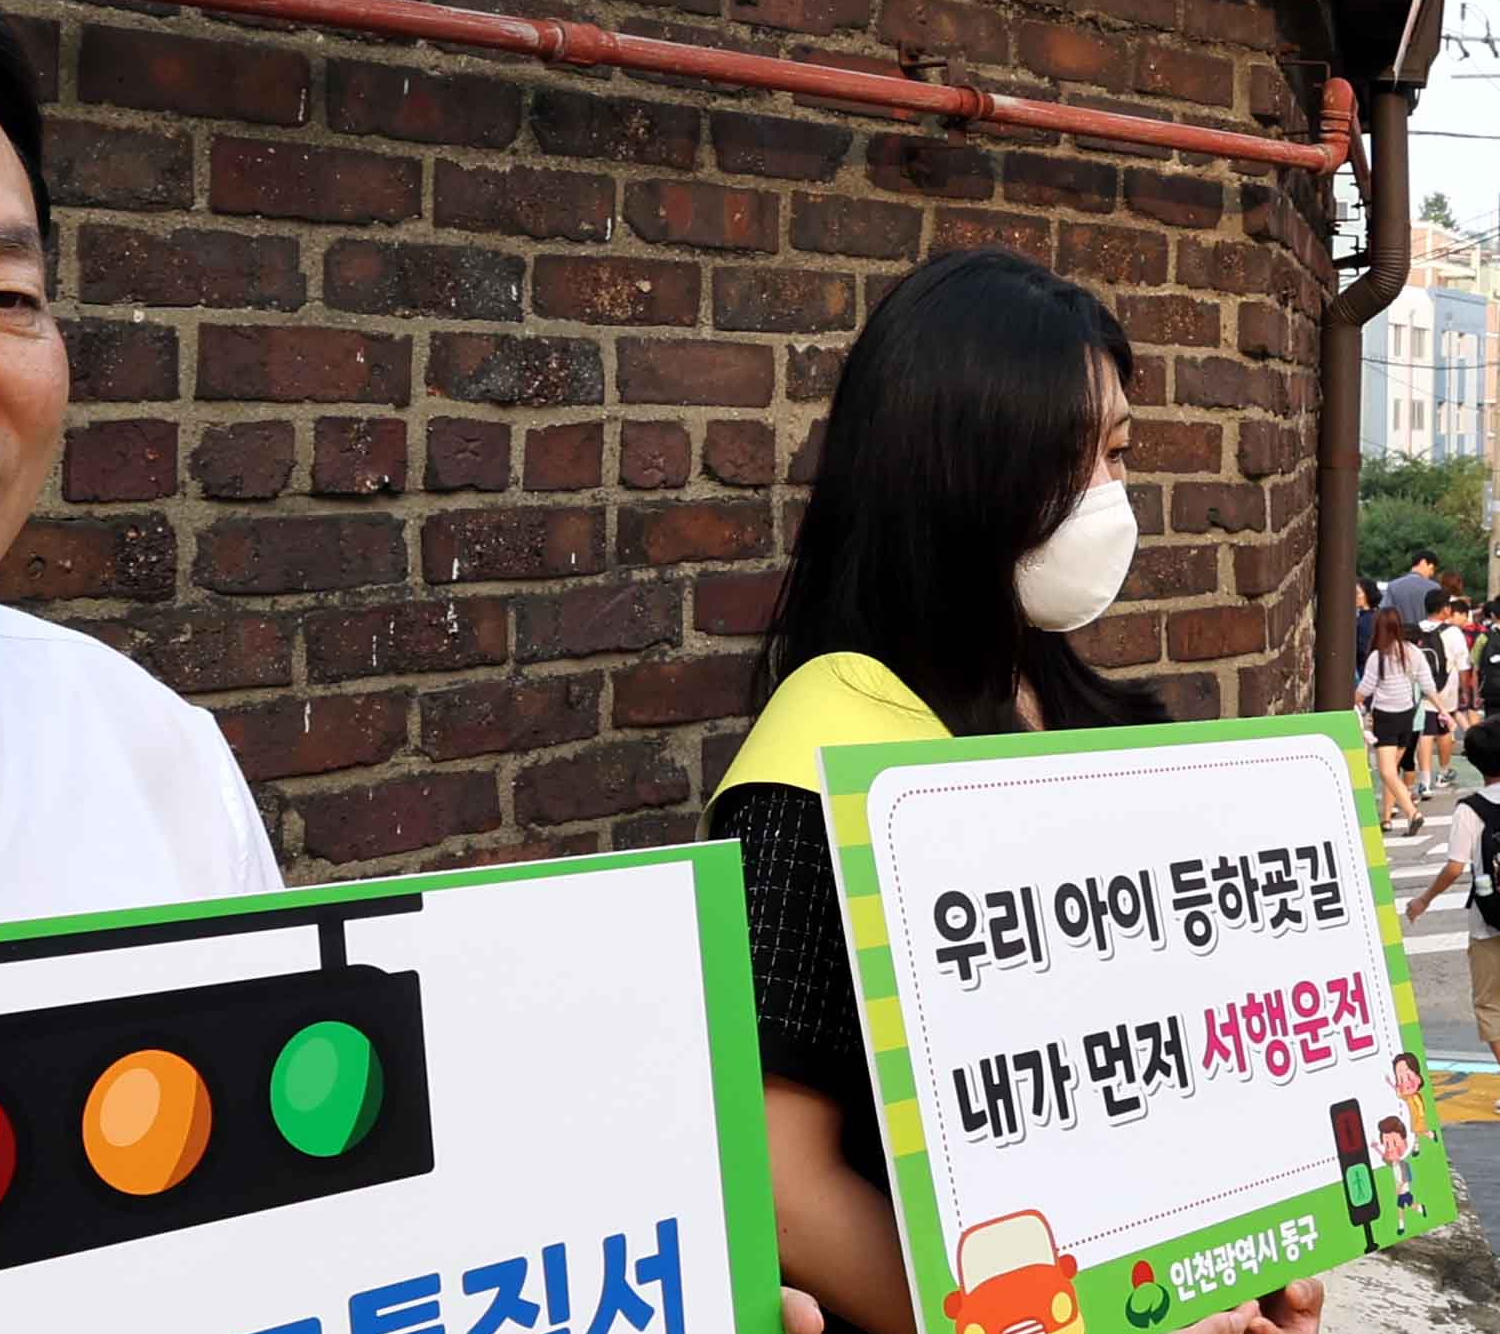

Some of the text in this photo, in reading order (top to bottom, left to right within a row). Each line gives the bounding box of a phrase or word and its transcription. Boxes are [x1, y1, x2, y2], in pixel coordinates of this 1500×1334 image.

[933, 840, 1345, 982] 우리 아이 등하굣길
[953, 971, 1375, 1142] 내가 먼저 서행운전
[1169, 1214, 1320, 1302] 인천광역시 동구
